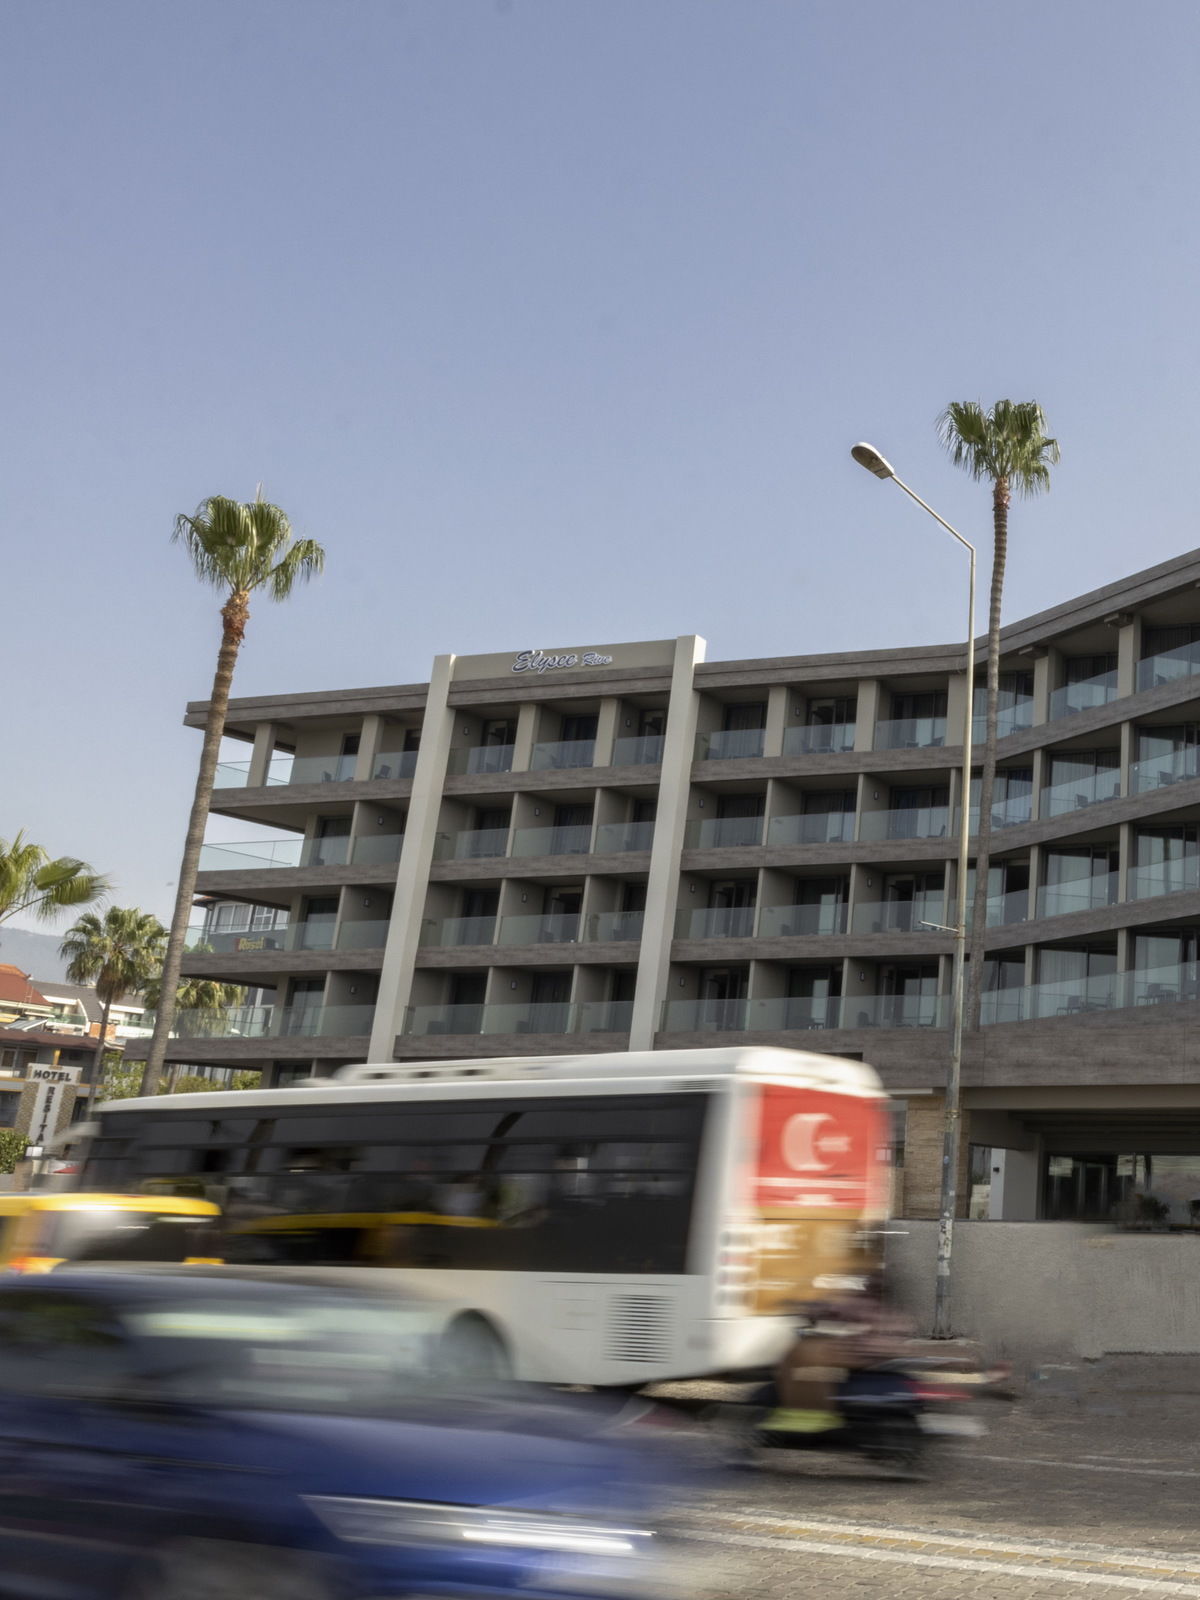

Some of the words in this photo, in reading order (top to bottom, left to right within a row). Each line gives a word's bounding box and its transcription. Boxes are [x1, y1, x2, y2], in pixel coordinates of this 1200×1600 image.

[512, 650, 577, 674] Elysee
[33, 1069, 72, 1082] HOTEL
[36, 1086, 56, 1145] RESITA
